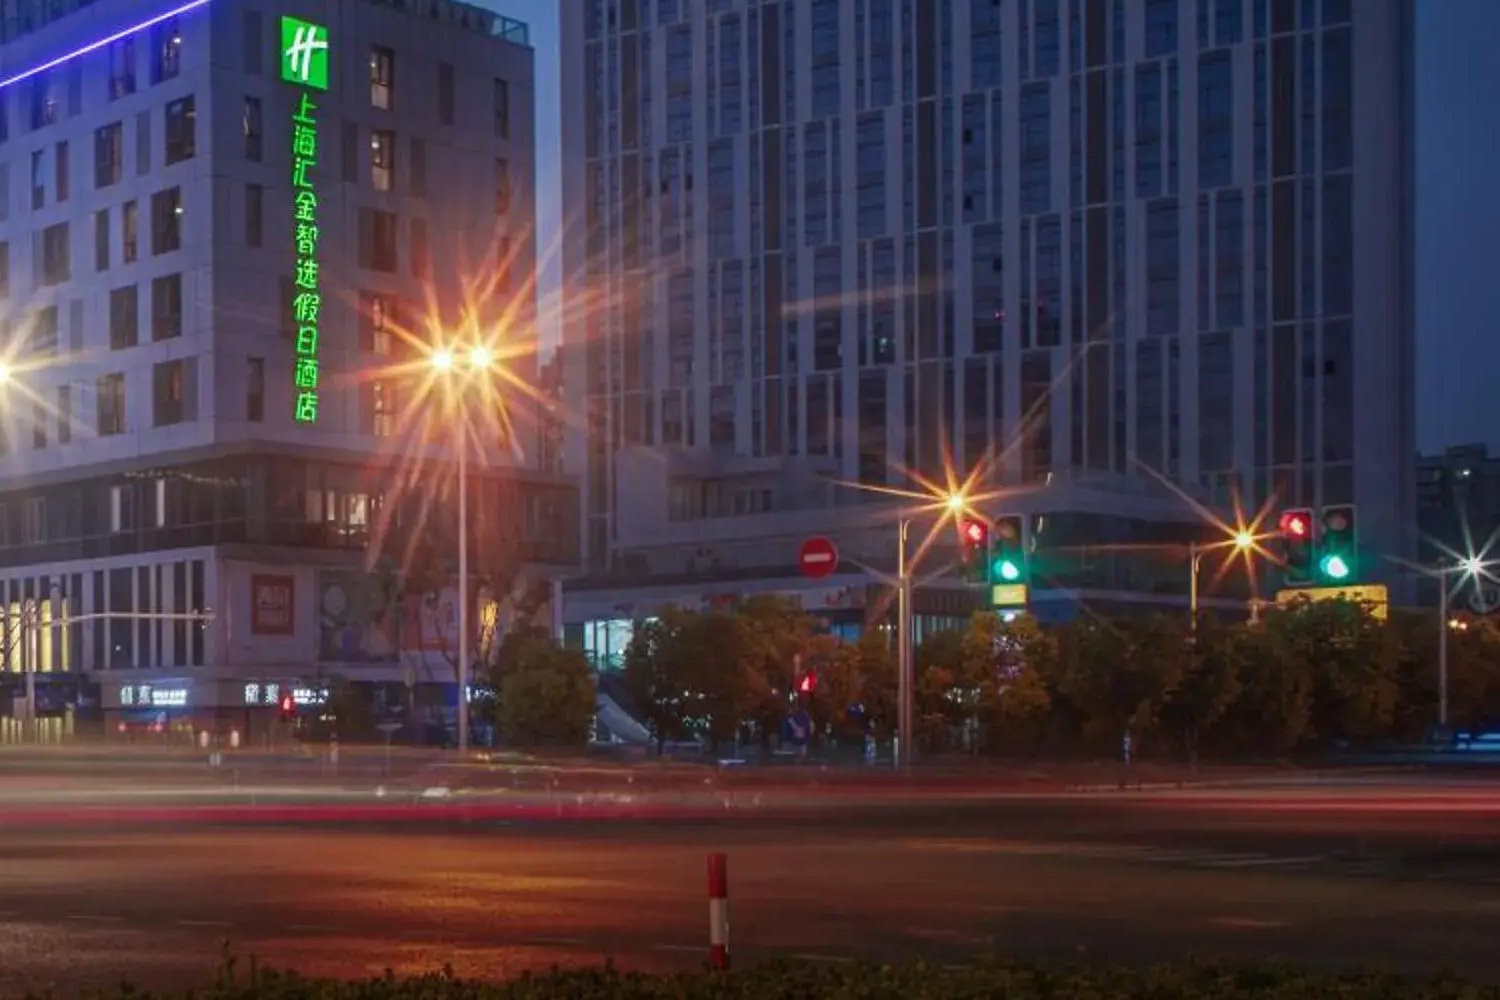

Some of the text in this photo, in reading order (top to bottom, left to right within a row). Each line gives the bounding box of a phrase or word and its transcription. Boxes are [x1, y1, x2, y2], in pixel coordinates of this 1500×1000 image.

[291, 92, 320, 423] 上海汇金智选假日酒店
